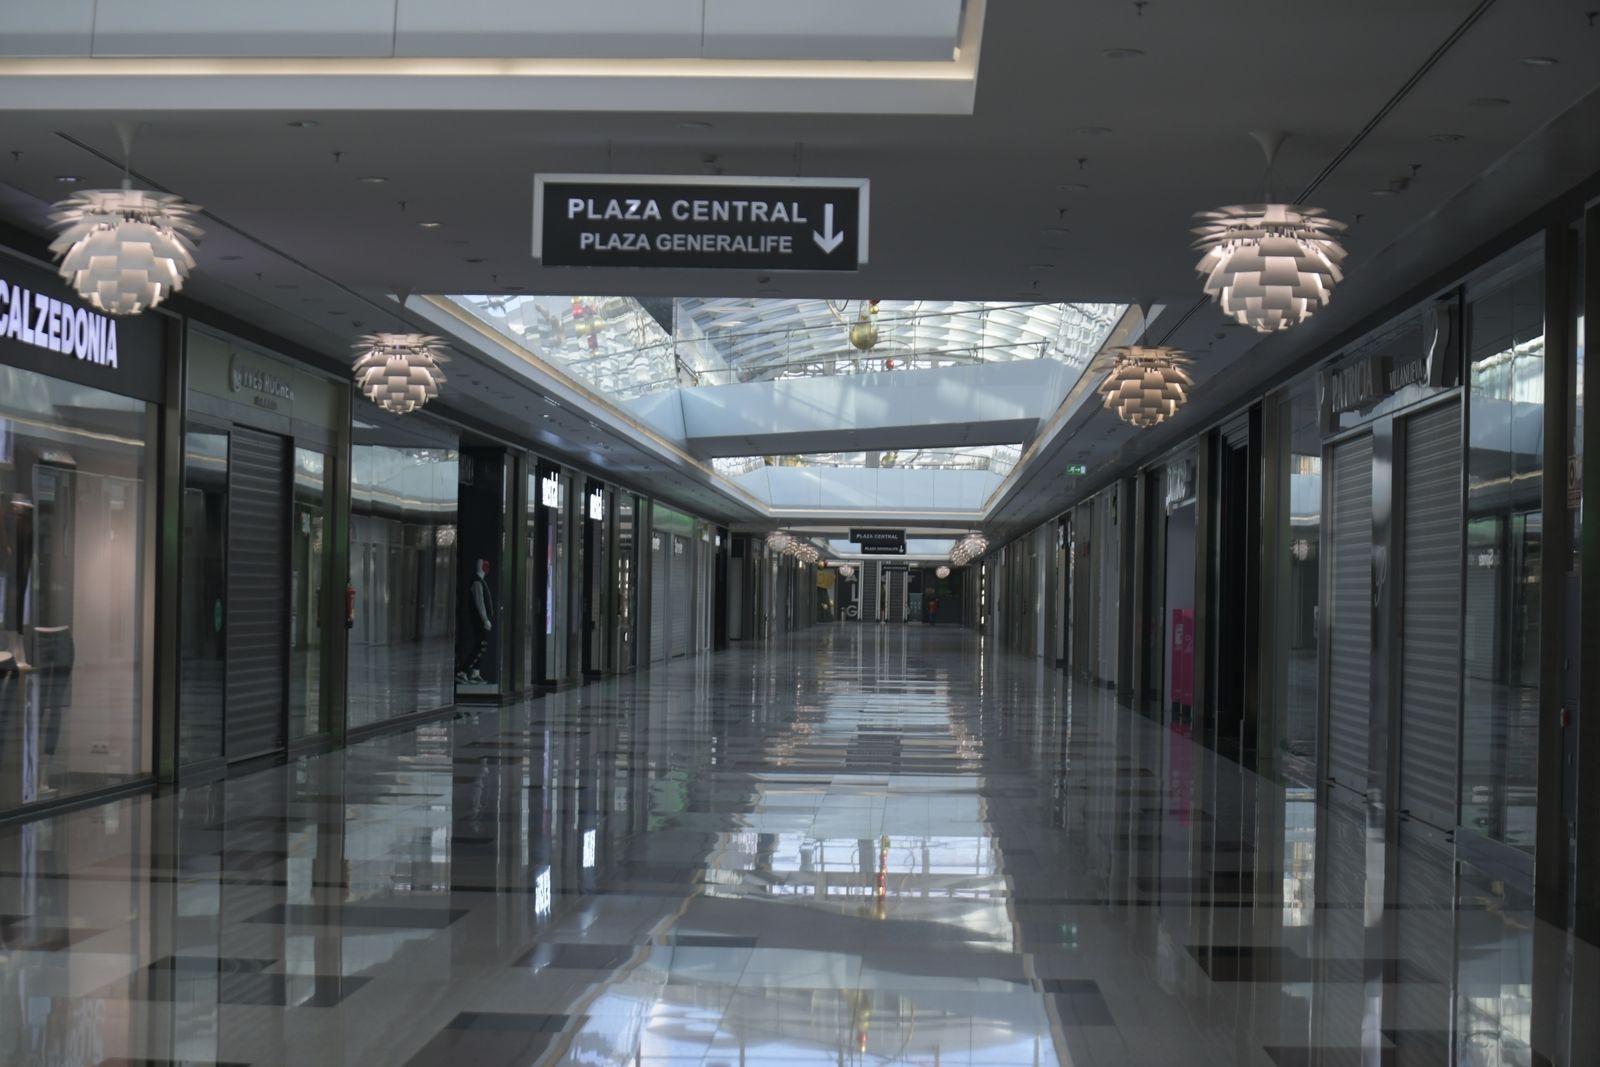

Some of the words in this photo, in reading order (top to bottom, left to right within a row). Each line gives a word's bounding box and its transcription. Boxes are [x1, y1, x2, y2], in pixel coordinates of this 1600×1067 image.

[567, 198, 662, 220] PLAZA
[671, 200, 808, 223] CENTRAL
[580, 232, 651, 251] PLAZA
[656, 234, 793, 253] GENERALIFE
[0, 279, 118, 369] CALZEDONIA
[1332, 353, 1374, 413] PATRICIA
